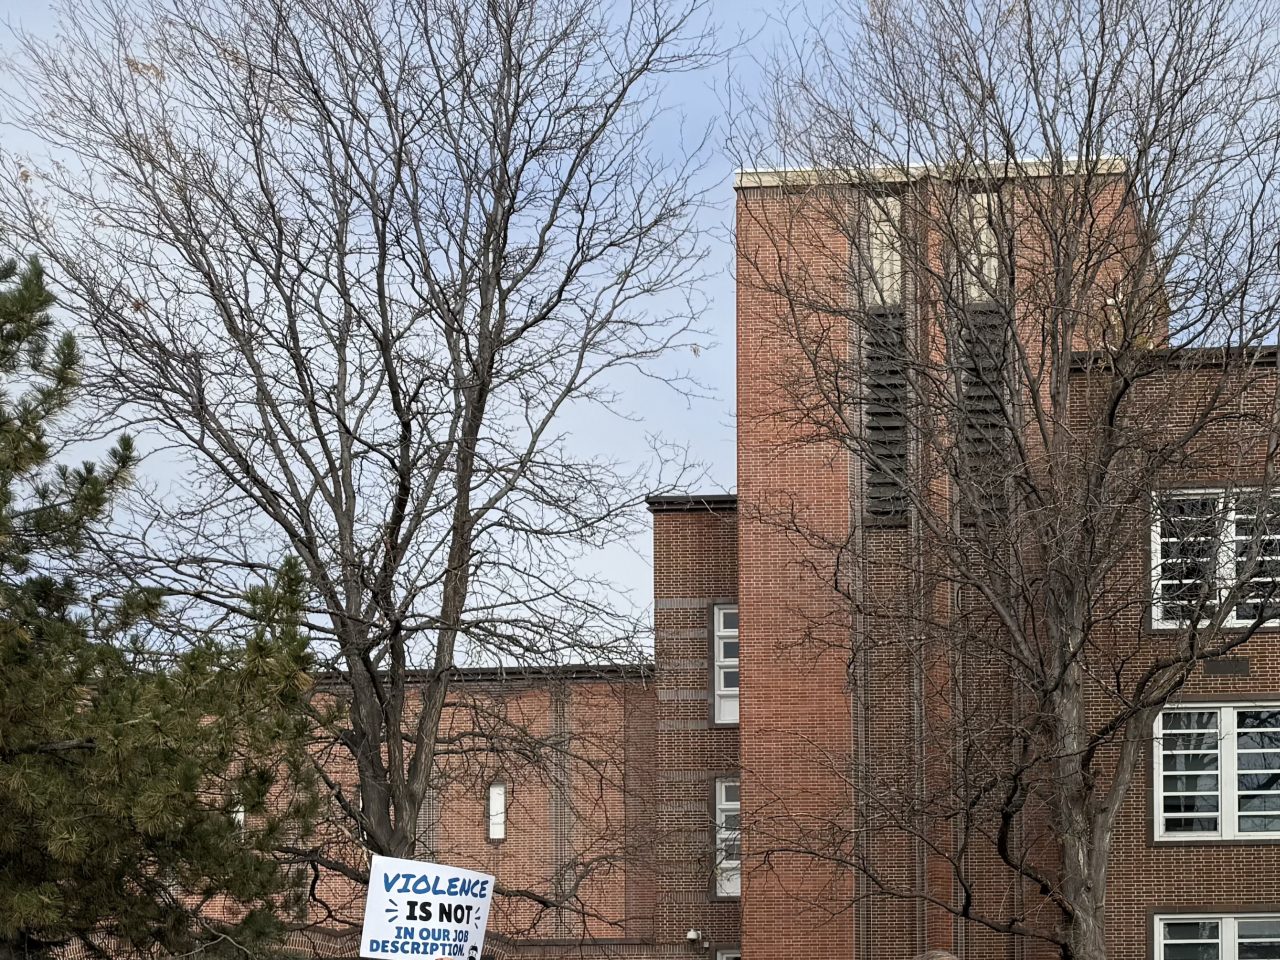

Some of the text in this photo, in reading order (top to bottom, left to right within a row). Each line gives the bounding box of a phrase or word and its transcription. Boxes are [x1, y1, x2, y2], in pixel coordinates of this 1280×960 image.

[383, 872, 489, 899] VIOLENCE
[406, 900, 473, 925] IS NOT
[394, 926, 469, 943] IN OUR JOB
[369, 939, 466, 957] DESCRIPTION.
